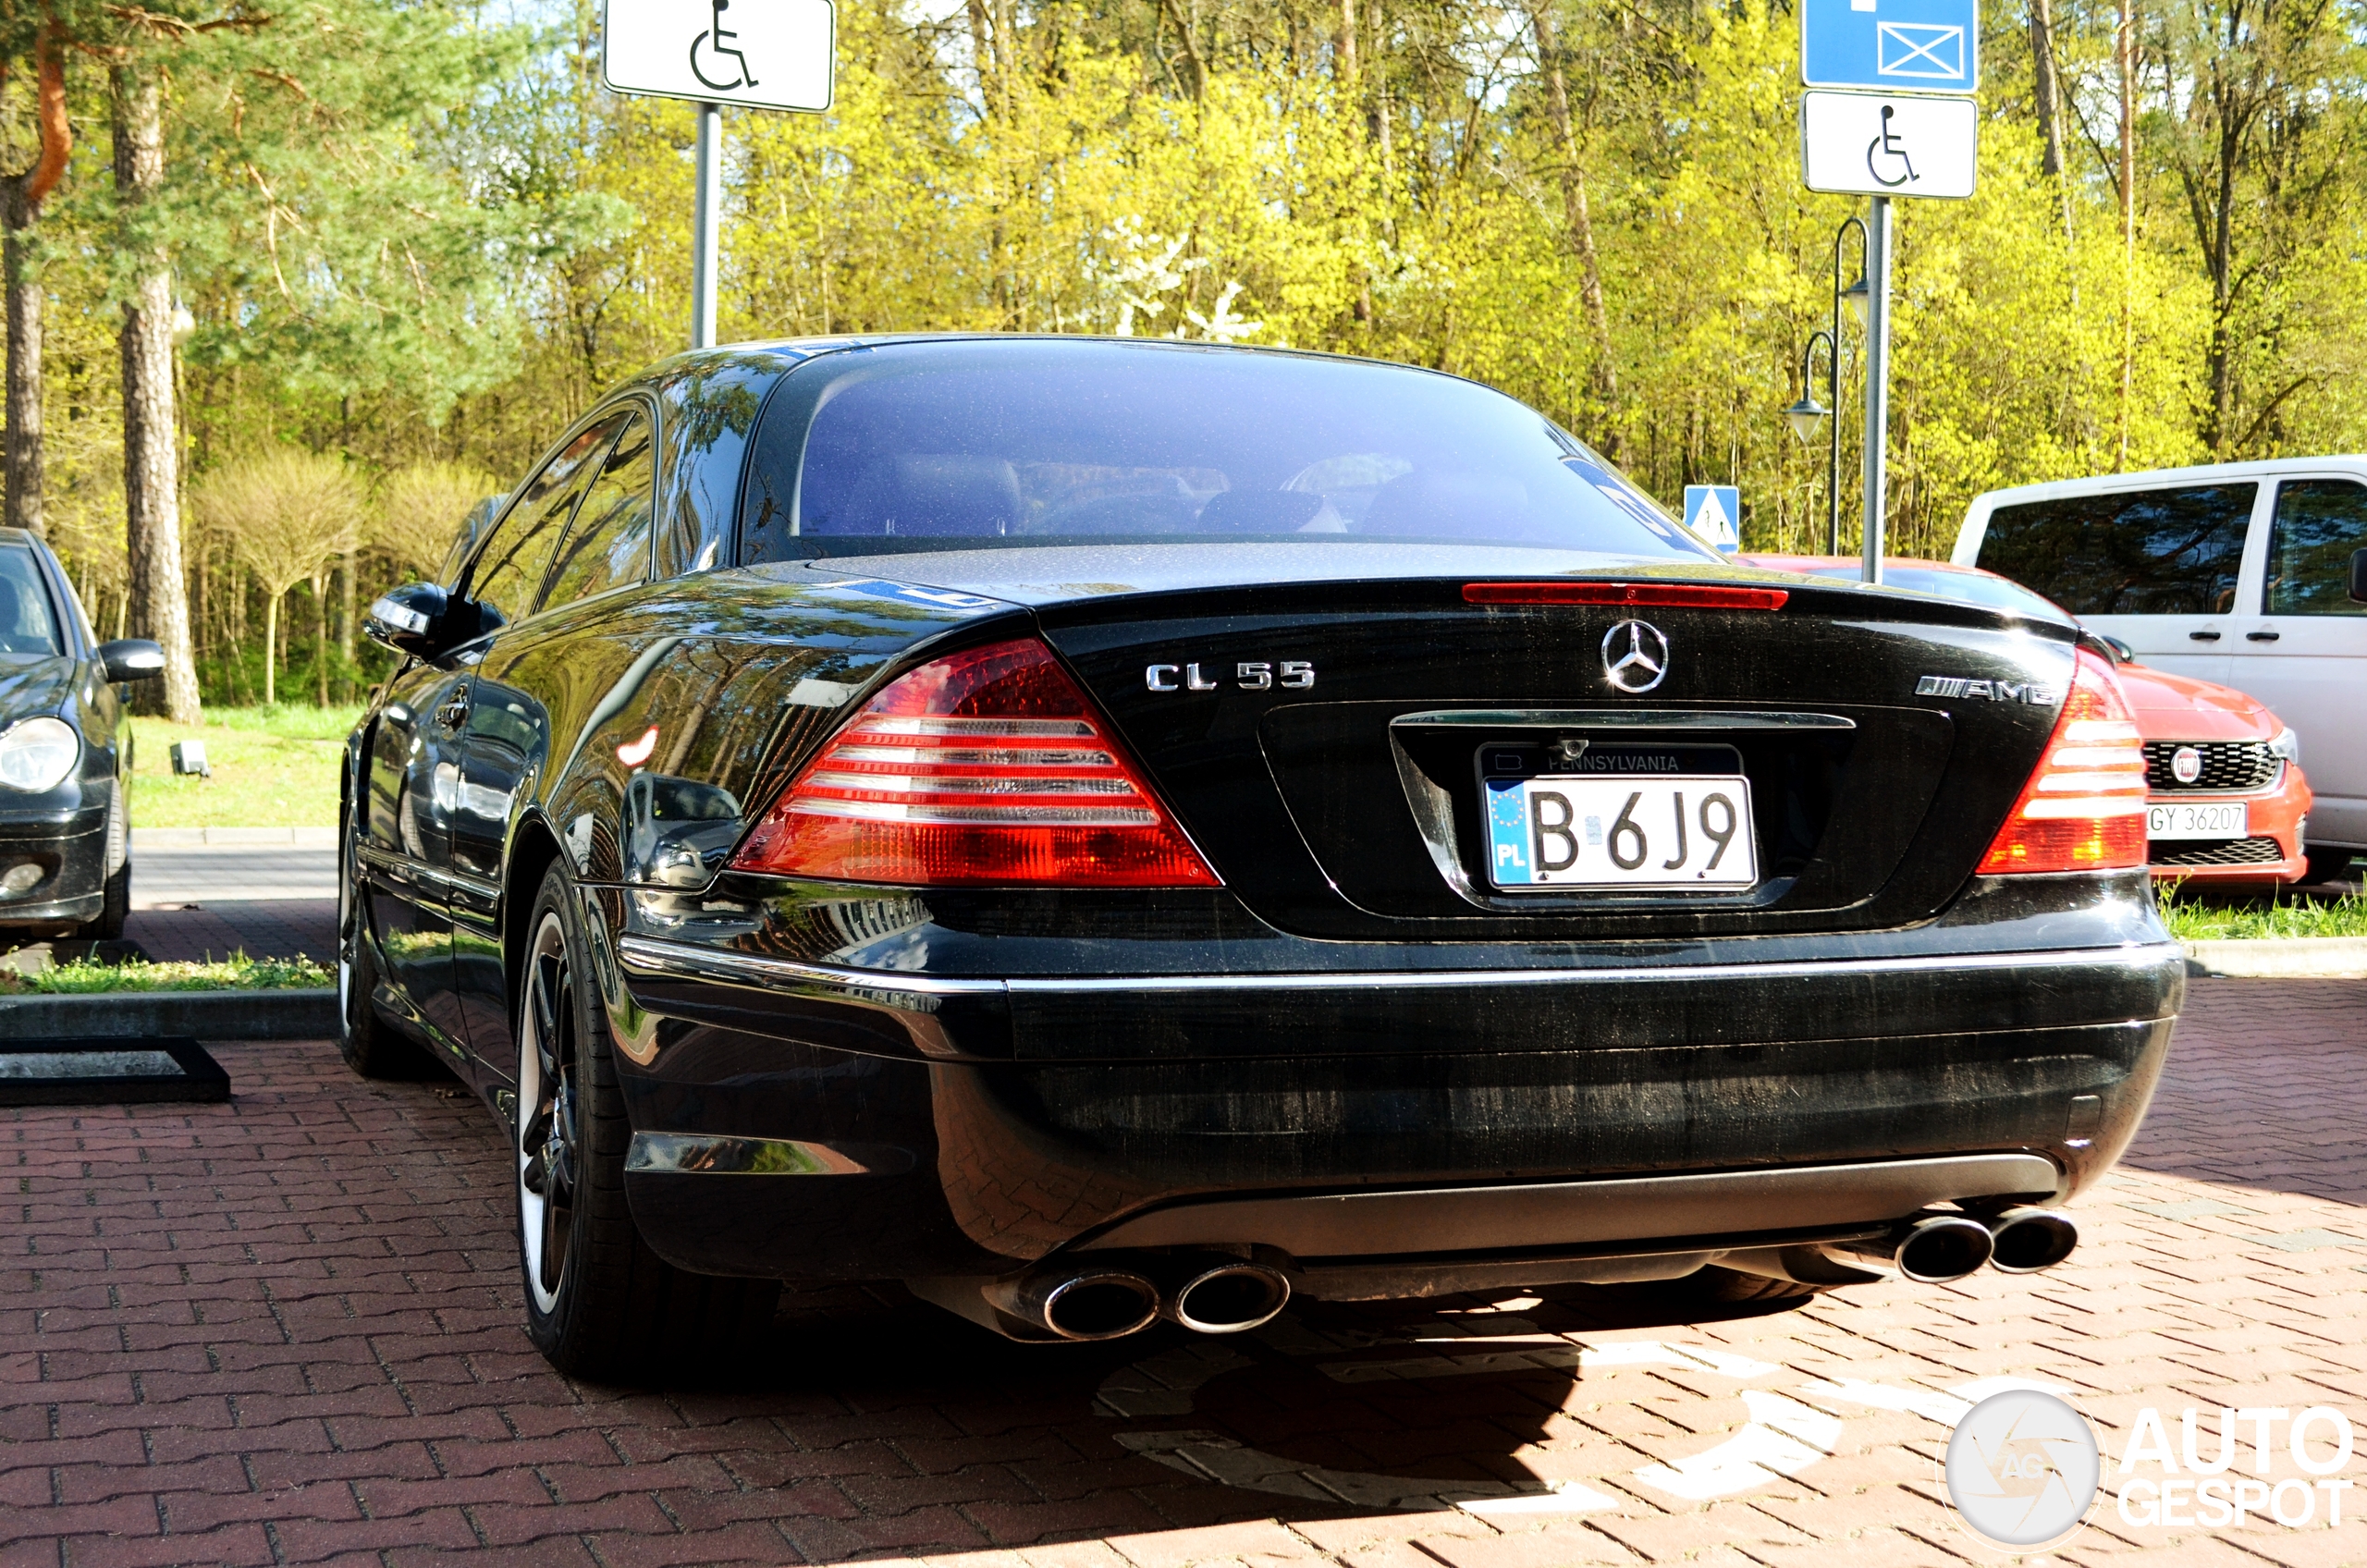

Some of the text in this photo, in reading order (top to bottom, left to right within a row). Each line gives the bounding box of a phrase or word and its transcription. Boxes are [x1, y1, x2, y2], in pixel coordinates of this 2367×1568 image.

[1146, 661, 1315, 692] CL 55
[2178, 758, 2197, 774] FIAT
[1529, 791, 1736, 871] B 6J9
[2146, 807, 2242, 831] GY 36207
[1496, 844, 1526, 867] PL
